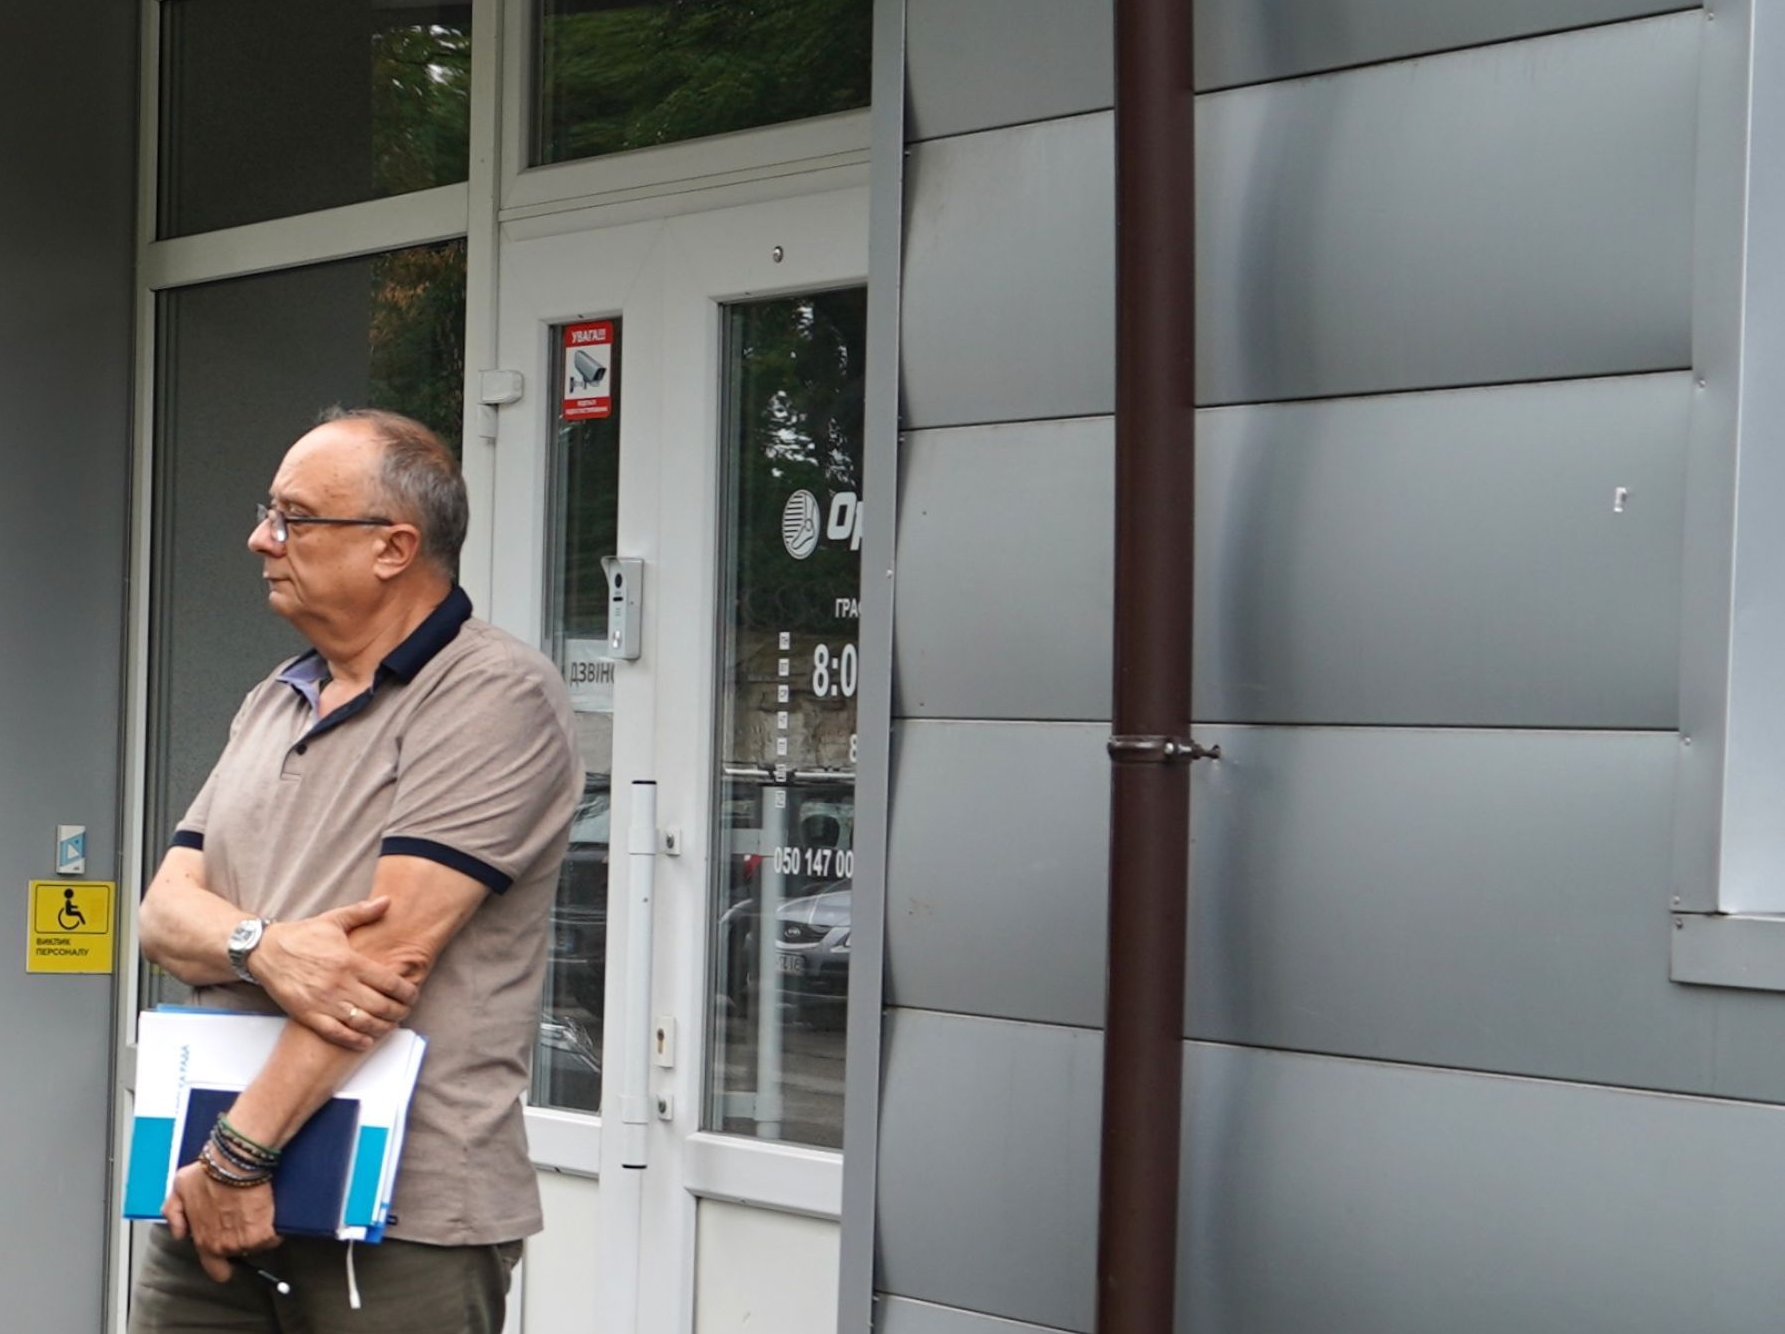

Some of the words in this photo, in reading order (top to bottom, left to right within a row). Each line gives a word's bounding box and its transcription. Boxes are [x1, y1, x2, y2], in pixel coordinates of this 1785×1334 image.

[835, 598, 862, 618] ГРА
[773, 846, 800, 875] 050
[805, 848, 832, 878] 147
[835, 850, 855, 879] 00
[36, 947, 90, 957] ПЕРСОНАЛУ
